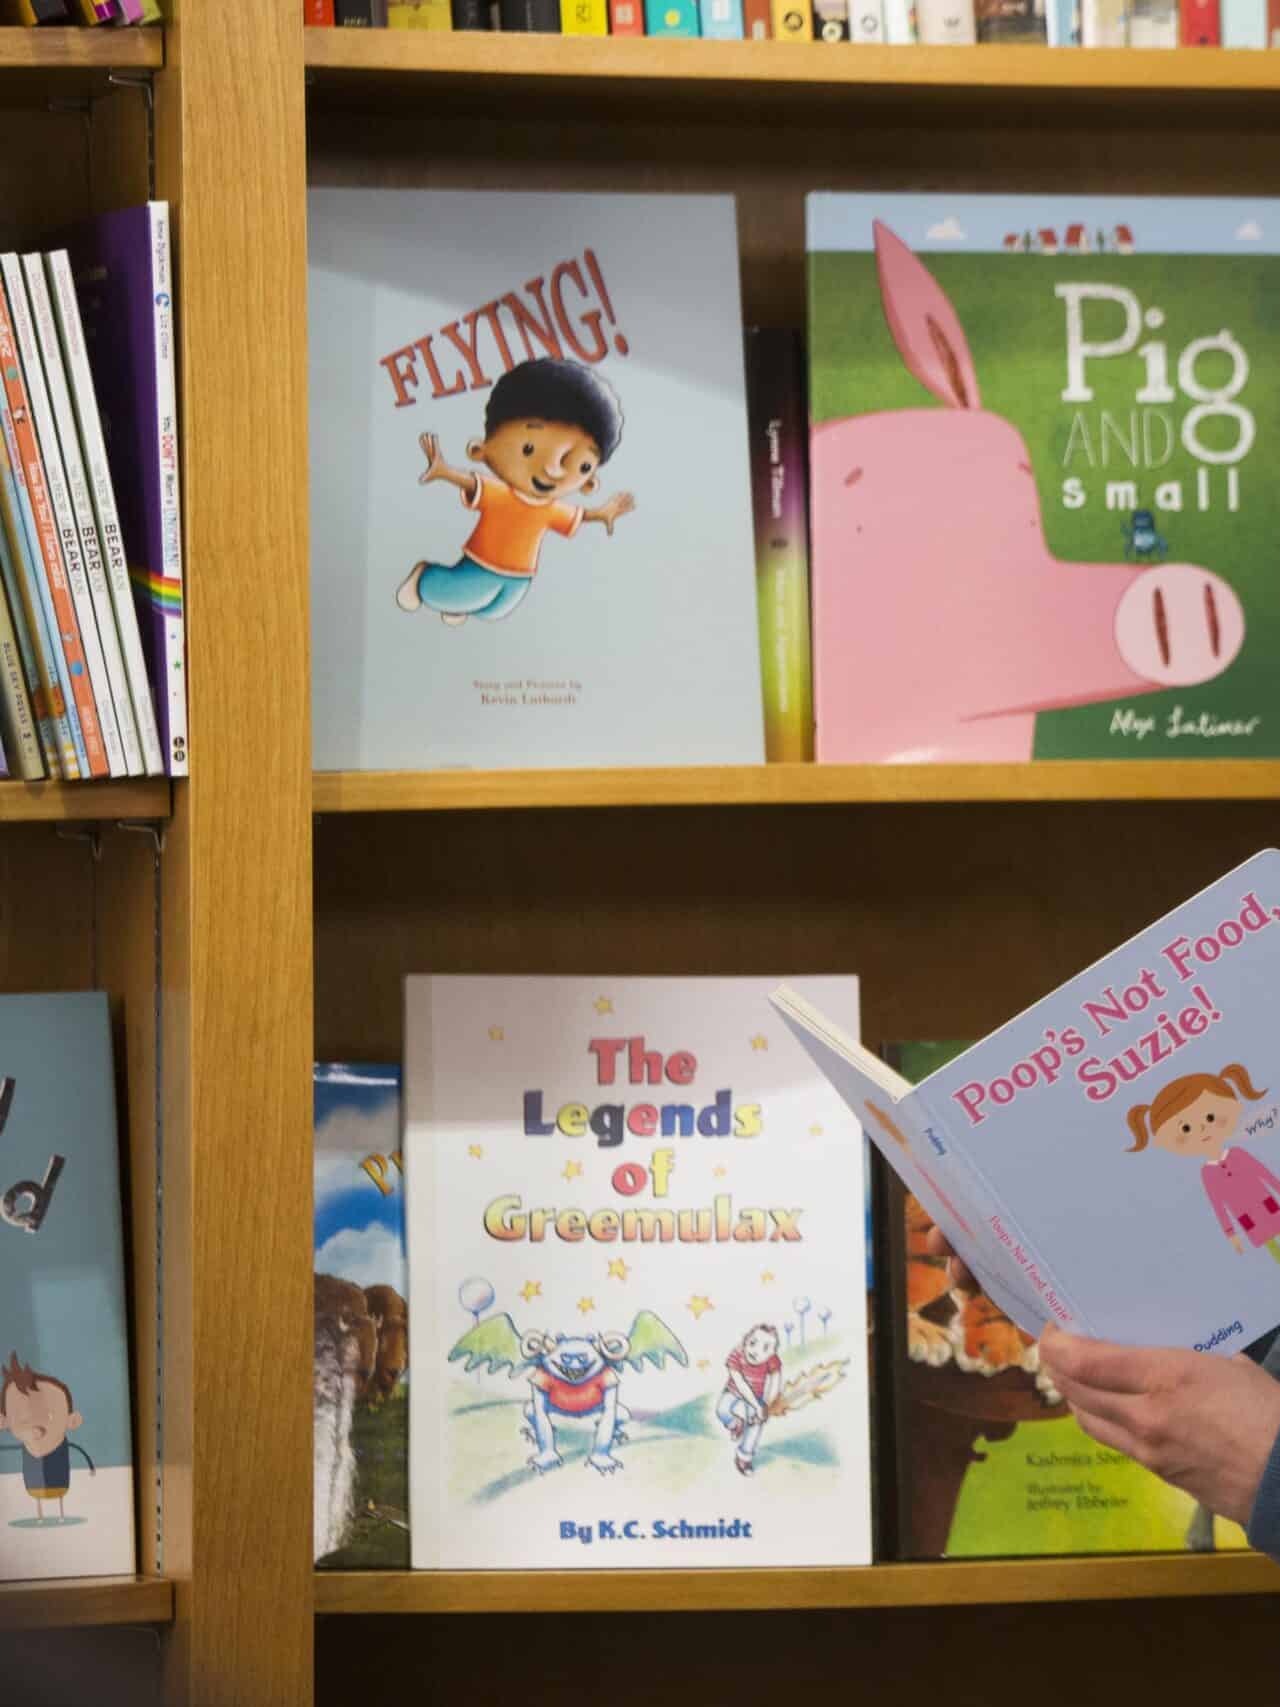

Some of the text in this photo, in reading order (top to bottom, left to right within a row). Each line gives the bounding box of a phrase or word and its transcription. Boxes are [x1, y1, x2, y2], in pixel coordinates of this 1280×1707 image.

[379, 246, 630, 408] FLYING!
[1054, 281, 1257, 465] Pig
[1063, 410, 1174, 469] AND
[588, 1035, 698, 1086] The
[952, 1027, 1087, 1126] Poop's
[1081, 967, 1168, 1037] Not
[1075, 984, 1223, 1102] Suzie!
[523, 1088, 764, 1148] Legends
[611, 1148, 676, 1198] of
[483, 1194, 805, 1243] Greemulax
[559, 1520, 593, 1545] By
[651, 1517, 754, 1540] Schmidt
